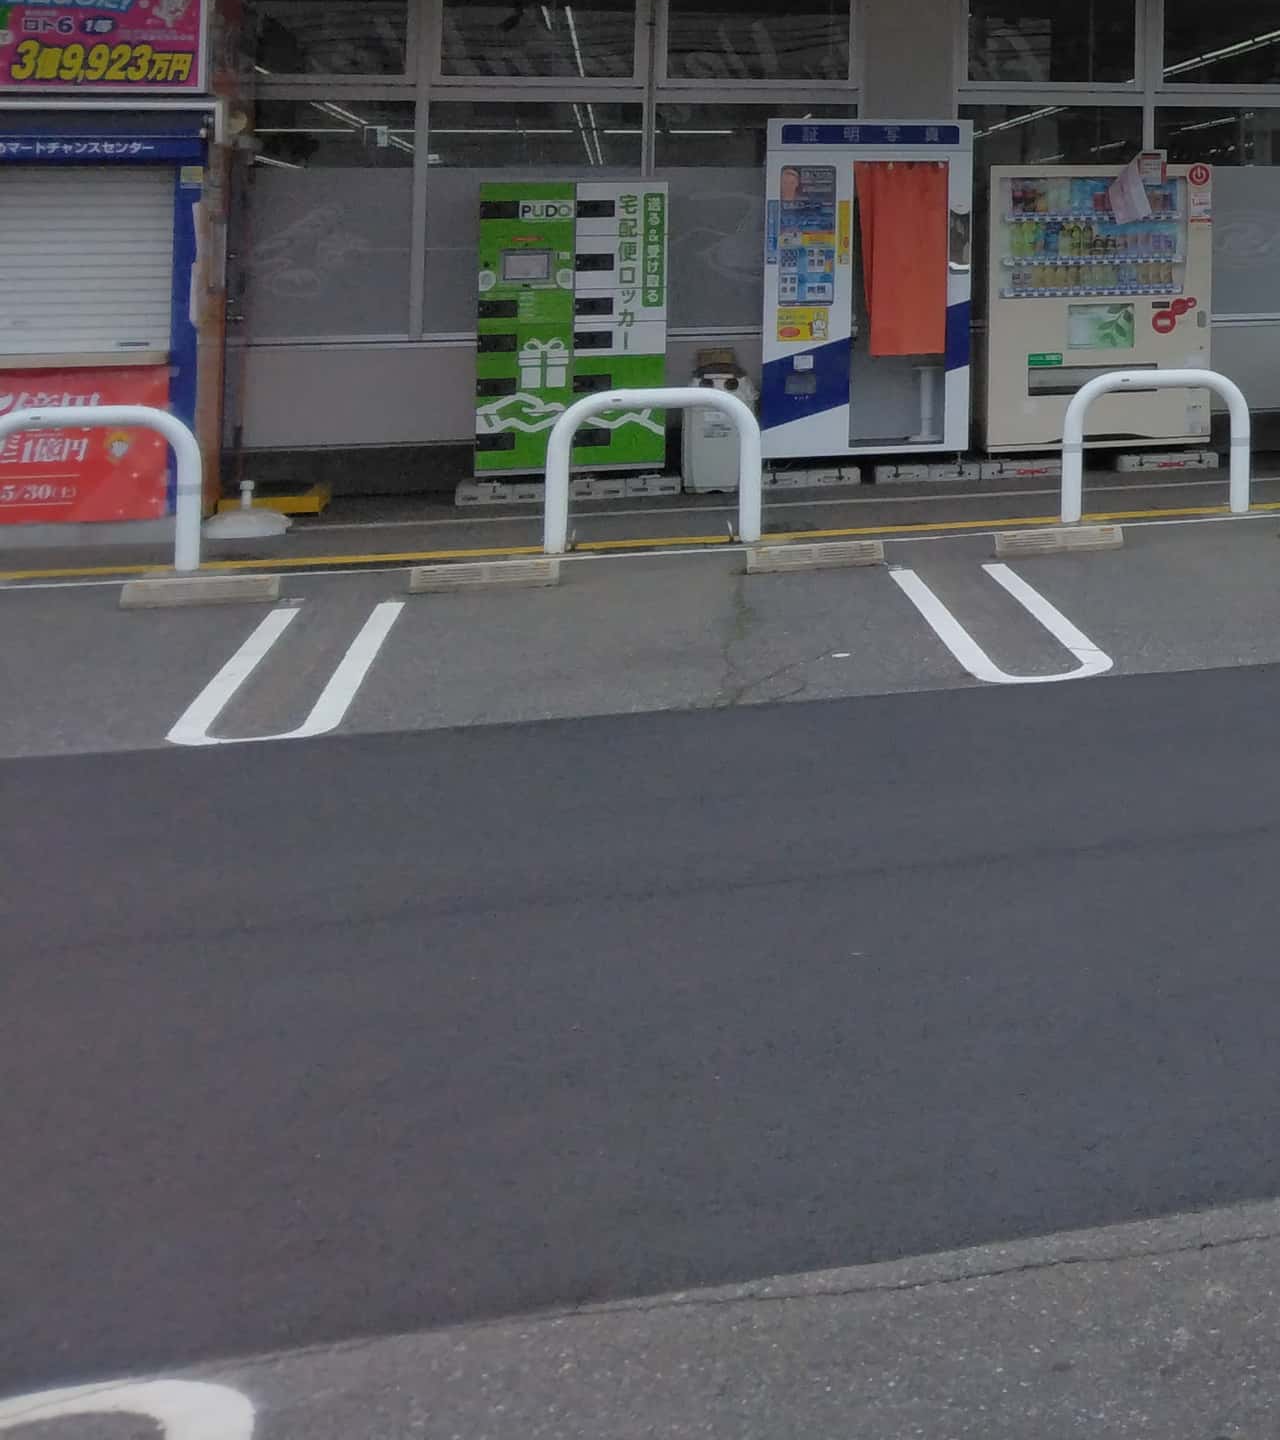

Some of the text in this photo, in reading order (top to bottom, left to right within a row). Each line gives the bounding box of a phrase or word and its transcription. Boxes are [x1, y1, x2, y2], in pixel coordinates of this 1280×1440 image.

[521, 203, 571, 218] PUDO
[617, 193, 638, 350] 宅配便ロッカー
